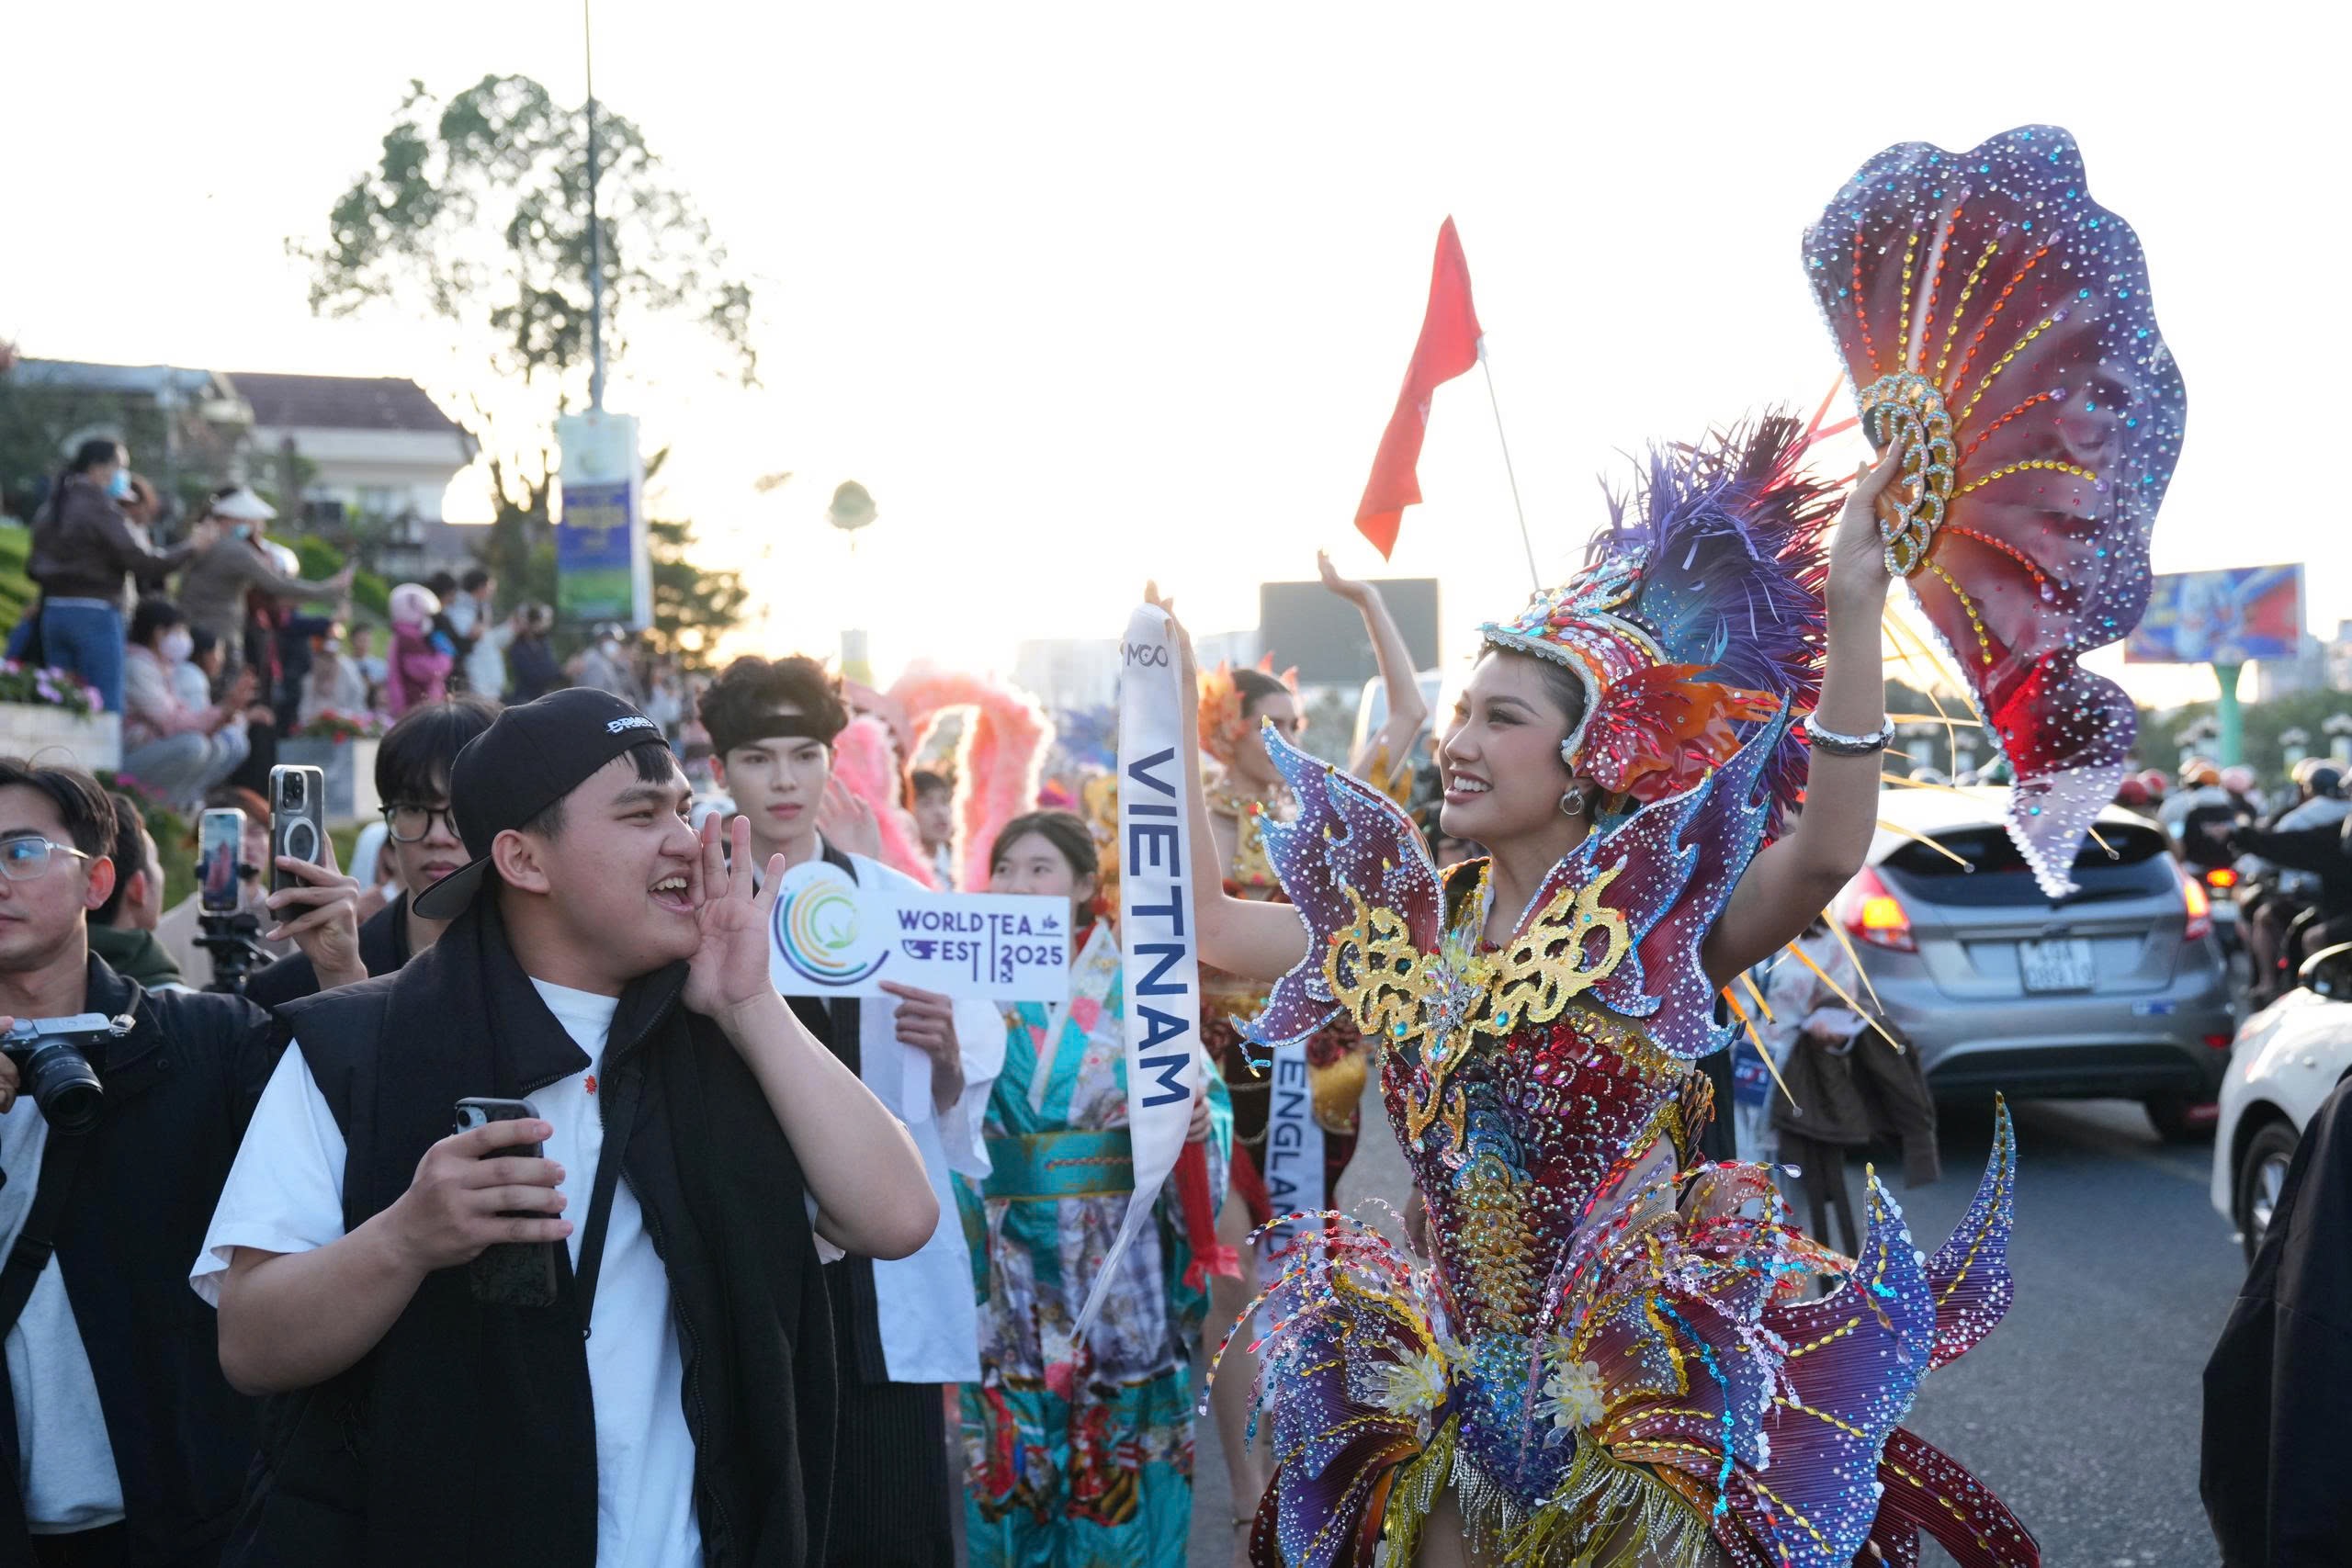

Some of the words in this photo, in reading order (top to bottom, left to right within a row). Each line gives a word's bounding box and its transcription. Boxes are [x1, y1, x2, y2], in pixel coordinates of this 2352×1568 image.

[898, 909, 983, 932] WORLD
[989, 913, 1032, 982] TEA
[921, 940, 981, 982] FEST
[1001, 944, 1063, 965] 2025
[1127, 747, 1190, 1108] VIETNAM
